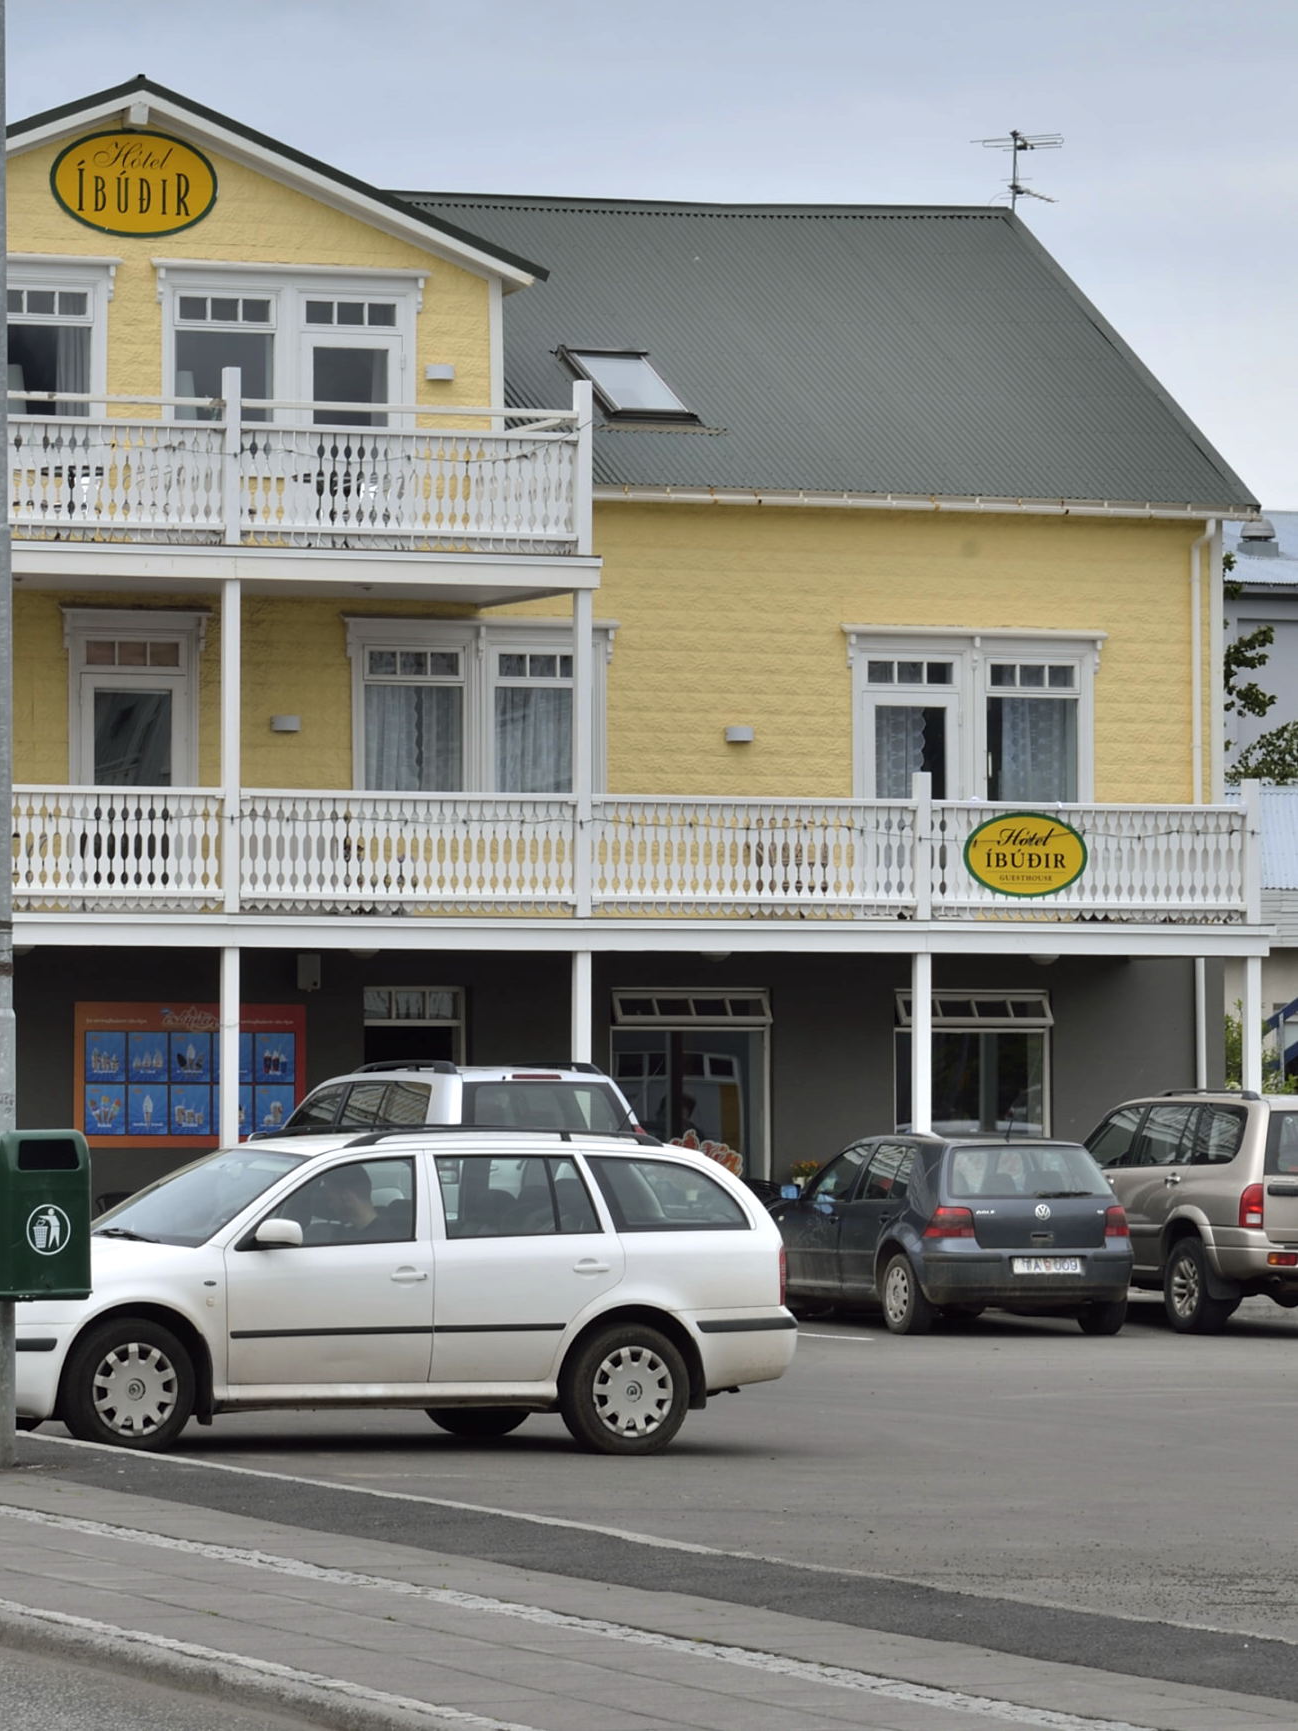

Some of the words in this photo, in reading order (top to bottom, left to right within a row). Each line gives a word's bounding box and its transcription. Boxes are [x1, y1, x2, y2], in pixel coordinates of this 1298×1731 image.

[93, 141, 174, 170] Hótel
[77, 159, 190, 217] ÍBÚÐIR
[997, 827, 1055, 847] Hótel
[985, 848, 1067, 869] ÍBÚÐIR
[999, 874, 1053, 882] GUESTHOUSE
